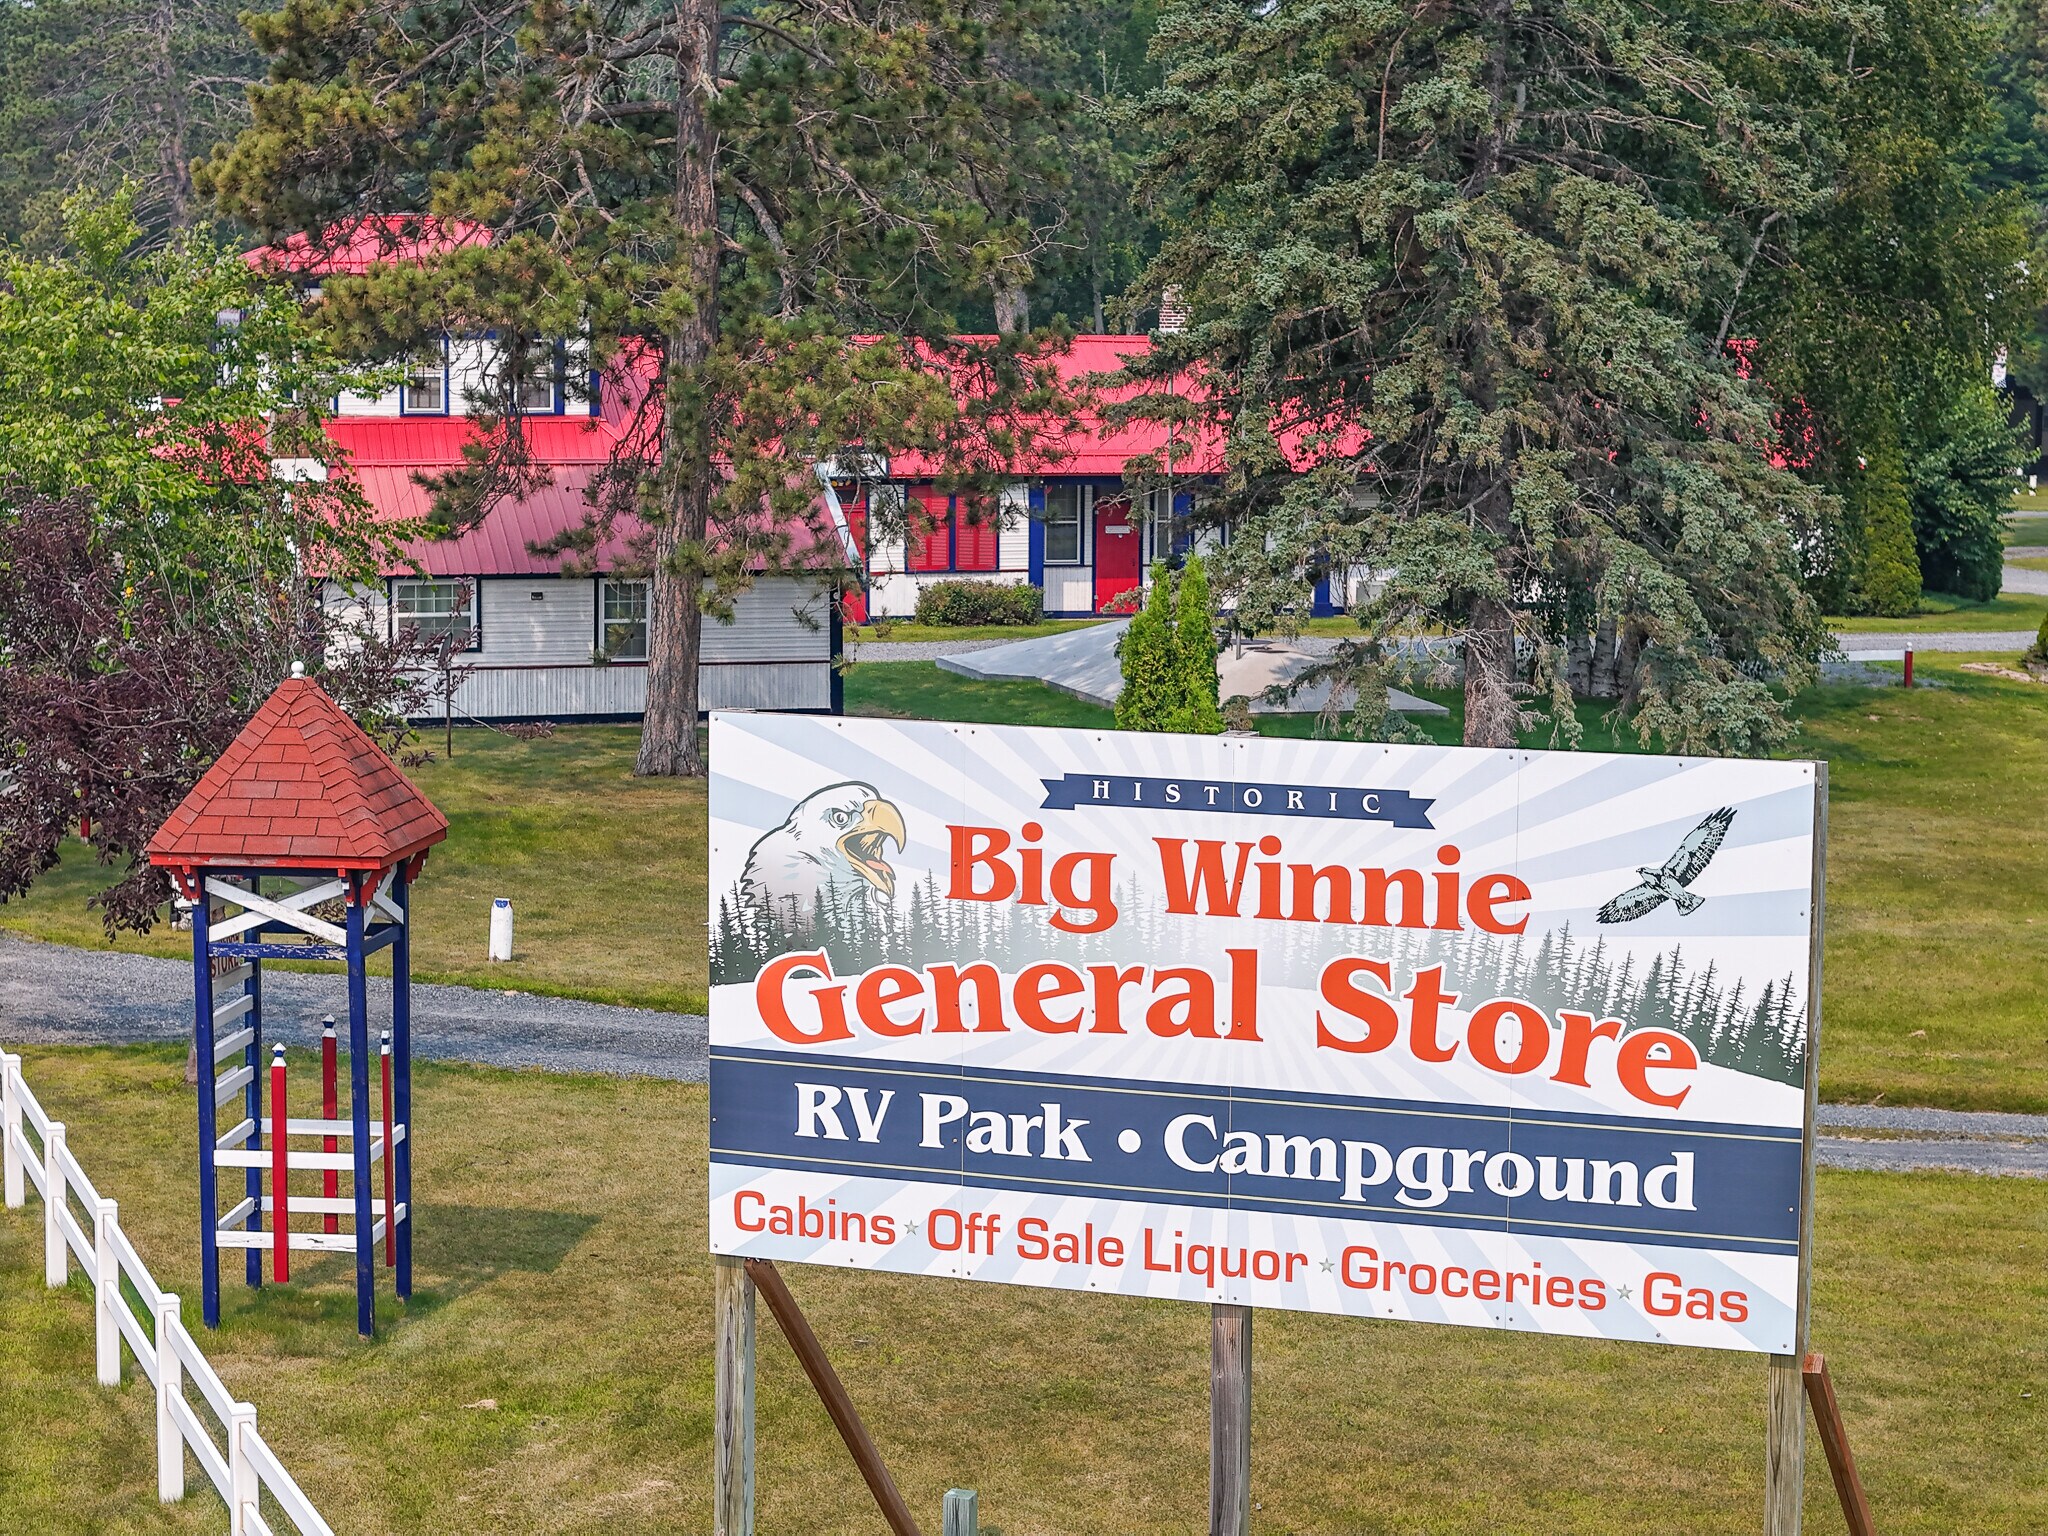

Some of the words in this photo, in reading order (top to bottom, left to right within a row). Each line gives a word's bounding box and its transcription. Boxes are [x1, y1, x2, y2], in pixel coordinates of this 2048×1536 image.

[1092, 780, 1381, 814] HISTORIC
[945, 821, 1119, 935] Big
[1152, 834, 1532, 935] Winnie
[755, 950, 1263, 1045] General
[1315, 957, 1698, 1110] Store
[794, 1082, 896, 1144] RV
[918, 1092, 1093, 1163] Park
[1164, 1113, 1698, 1211] Campground
[733, 1190, 896, 1245] Cabins
[927, 1207, 1001, 1256] Off
[1017, 1216, 1124, 1267] Sale
[1144, 1227, 1309, 1289] Liquor
[1341, 1245, 1607, 1311] Groceries
[1642, 1271, 1749, 1323] Gas
